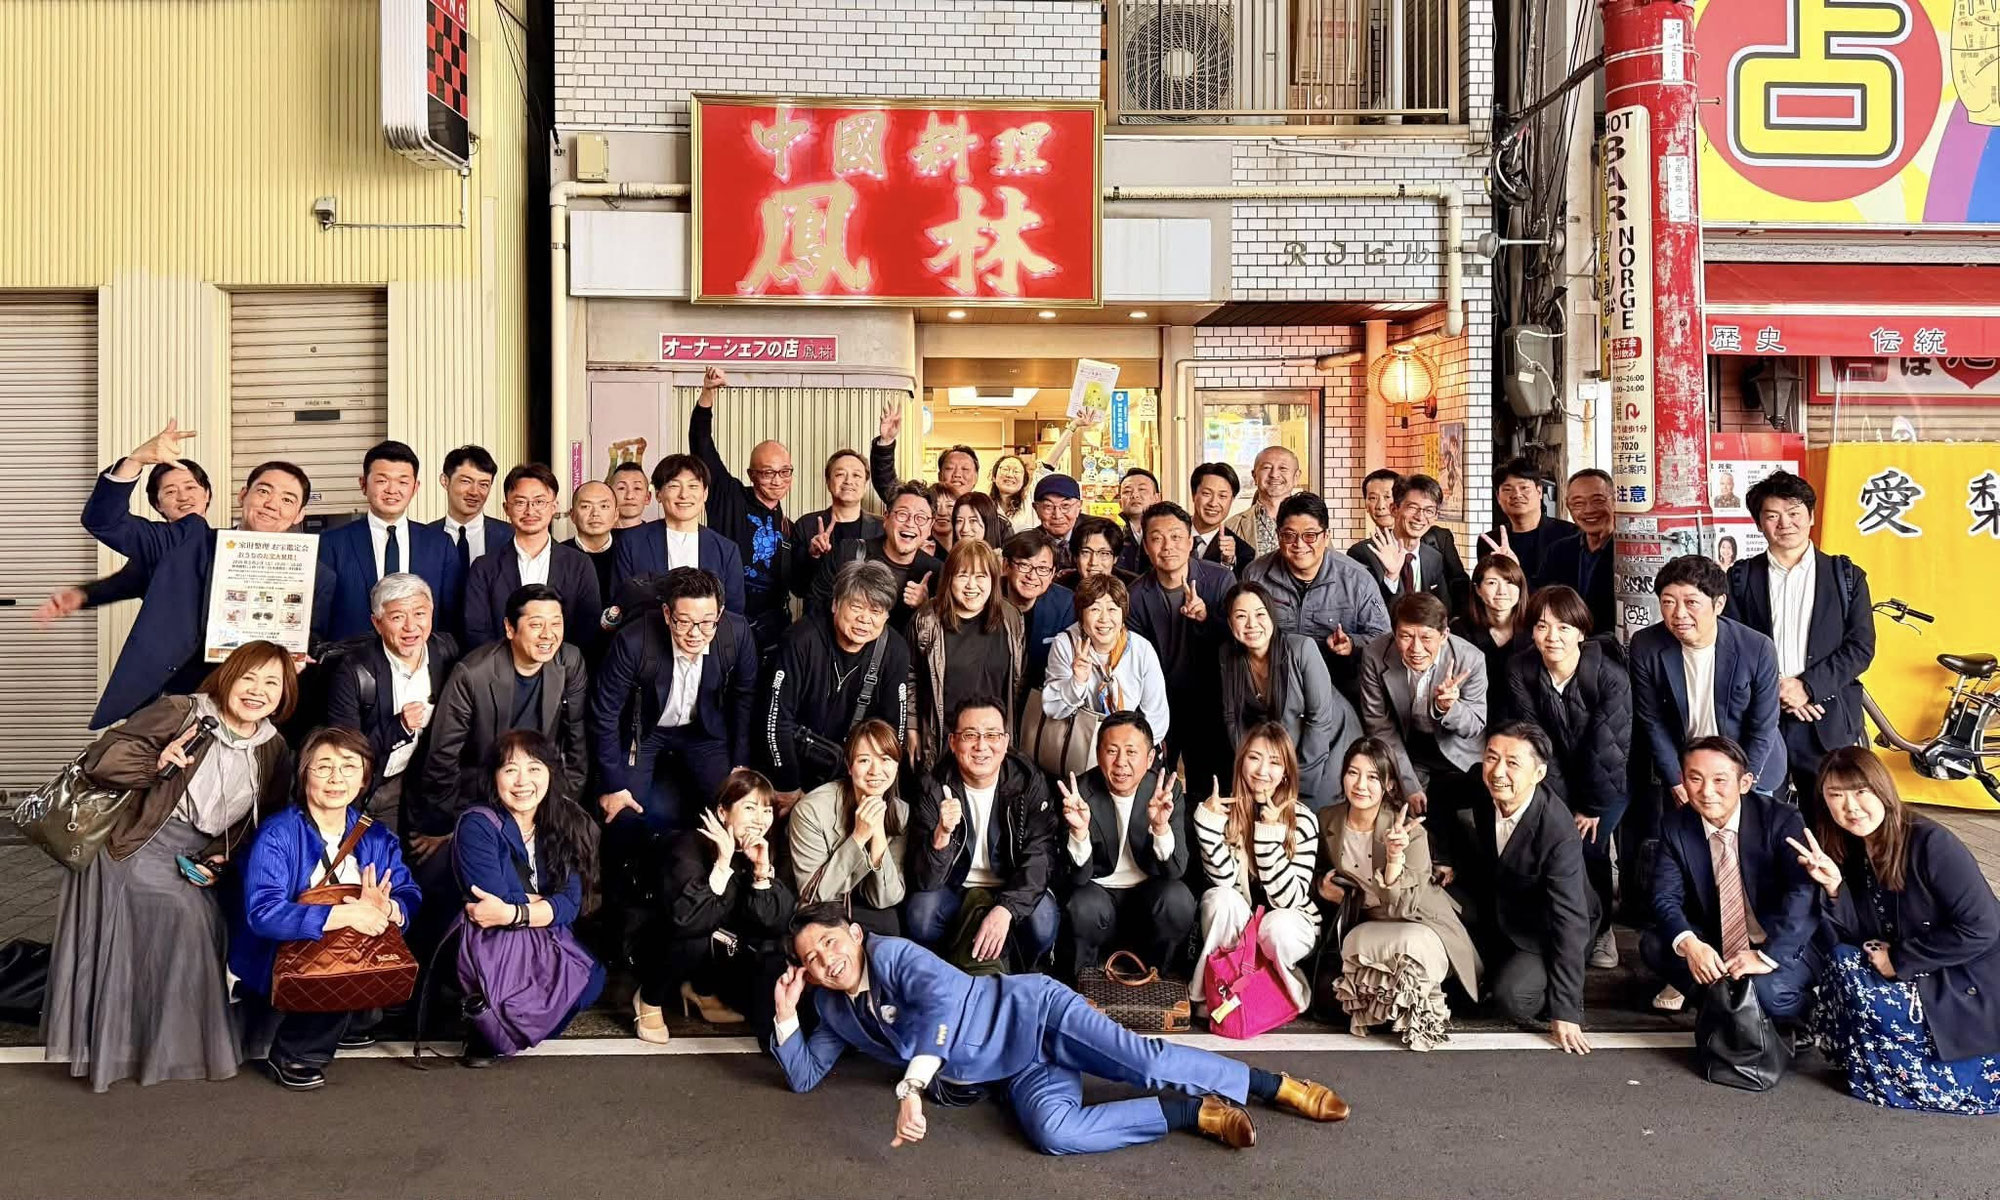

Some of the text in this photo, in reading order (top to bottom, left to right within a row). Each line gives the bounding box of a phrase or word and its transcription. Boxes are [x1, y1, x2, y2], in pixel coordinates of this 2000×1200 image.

[750, 107, 1052, 182] 中國料理
[737, 180, 1060, 295] 鳳林
[1618, 225, 1636, 330] NORGE
[664, 337, 799, 358] オーナーシェフの店
[1710, 325, 1946, 353] 歴史 伝統
[1616, 485, 1646, 502] 注意
